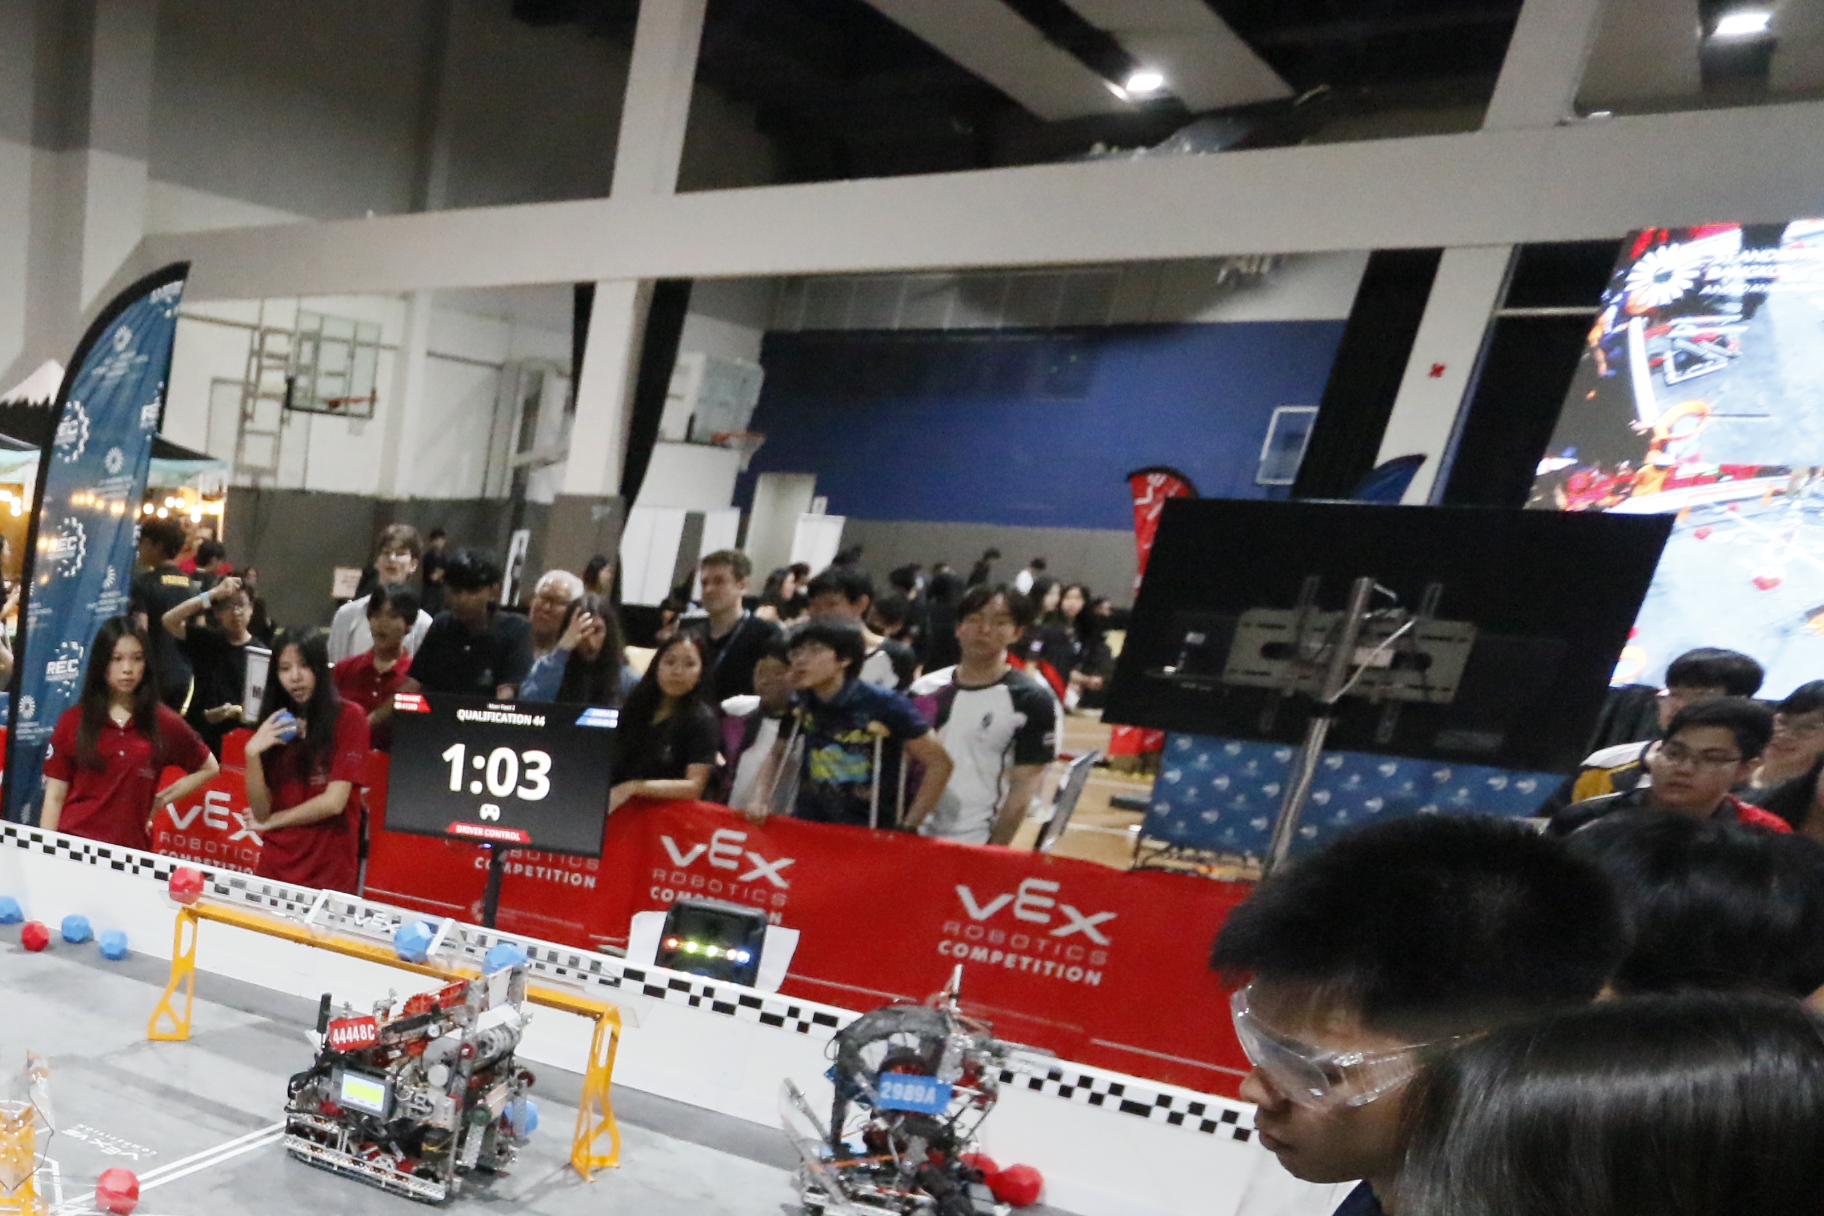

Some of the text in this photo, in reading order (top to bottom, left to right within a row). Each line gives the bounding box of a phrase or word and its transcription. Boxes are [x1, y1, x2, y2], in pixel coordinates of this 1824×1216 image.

[46, 659, 79, 675] REC
[457, 709, 546, 727] QUALIFICATION 44
[442, 743, 552, 801] 1:03
[166, 790, 264, 846] VEX
[456, 824, 521, 841] DRIVER CONTROL
[660, 828, 796, 889] VEX
[652, 868, 788, 907] ROBOTICS
[955, 878, 1118, 946] VEX
[937, 939, 1103, 986] COMPETITION
[943, 920, 1108, 966] ROBOTICS
[332, 1024, 376, 1044] 44448C
[880, 1081, 936, 1105] 2989A
